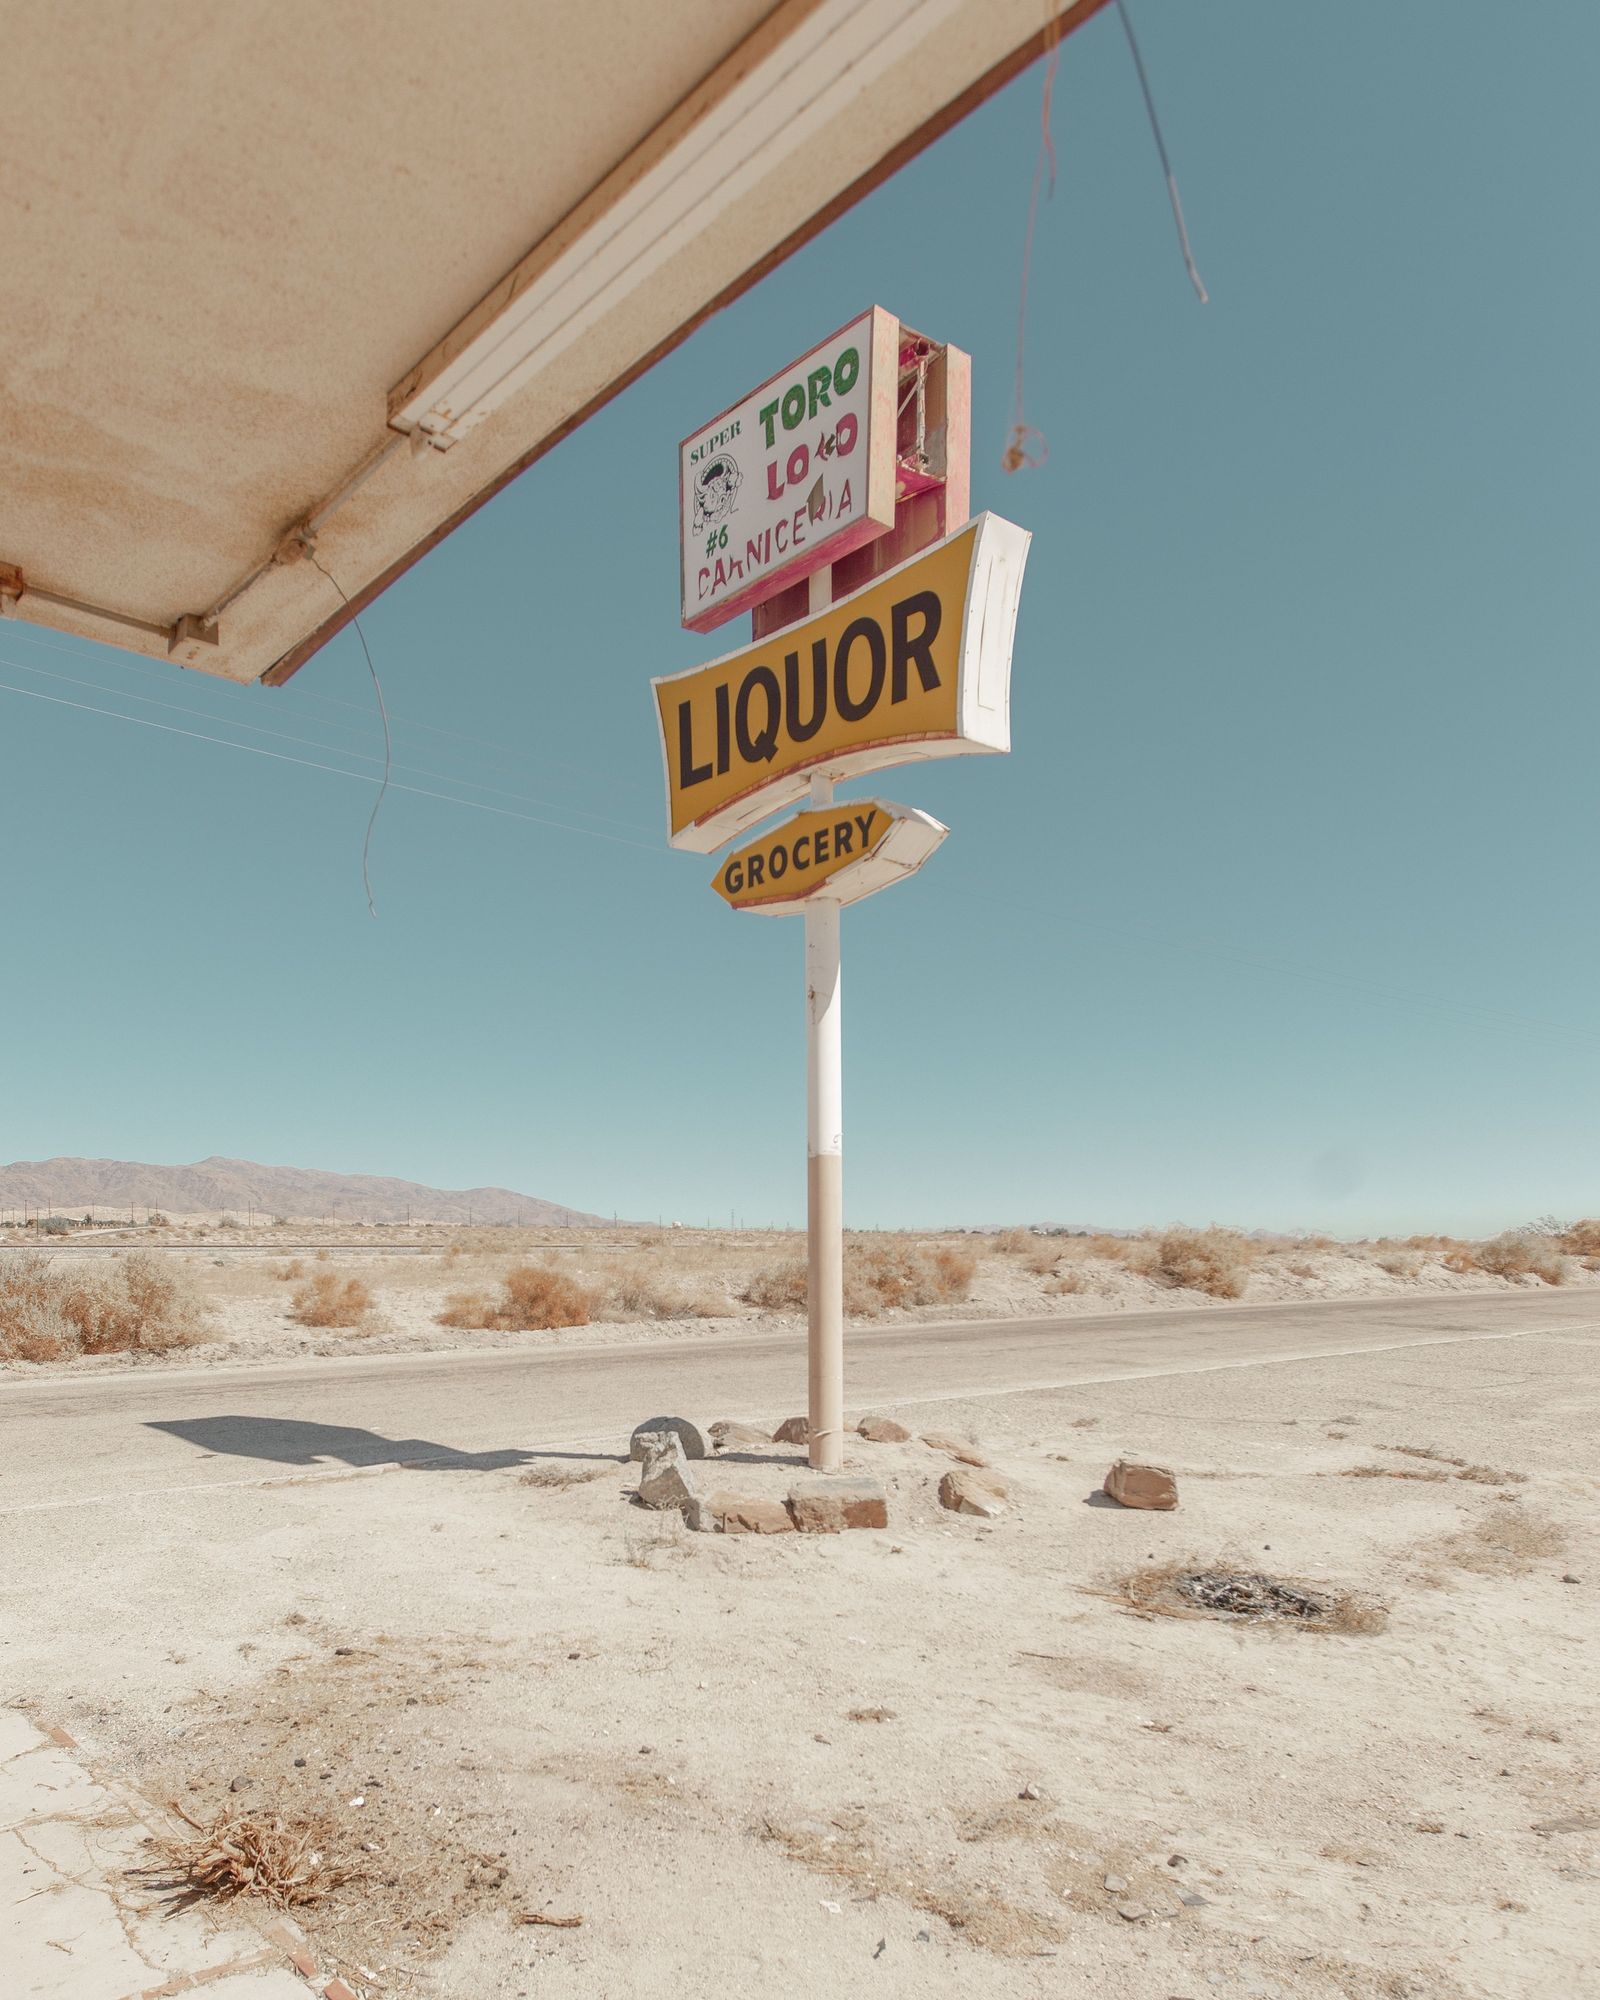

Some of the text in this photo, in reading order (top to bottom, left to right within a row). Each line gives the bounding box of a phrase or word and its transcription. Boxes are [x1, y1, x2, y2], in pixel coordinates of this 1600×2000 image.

[759, 347, 860, 449] TORO
[690, 420, 742, 467] SUPER
[706, 524, 729, 559] #6
[678, 590, 943, 790] LIQUOR
[724, 809, 877, 894] GROCERY
